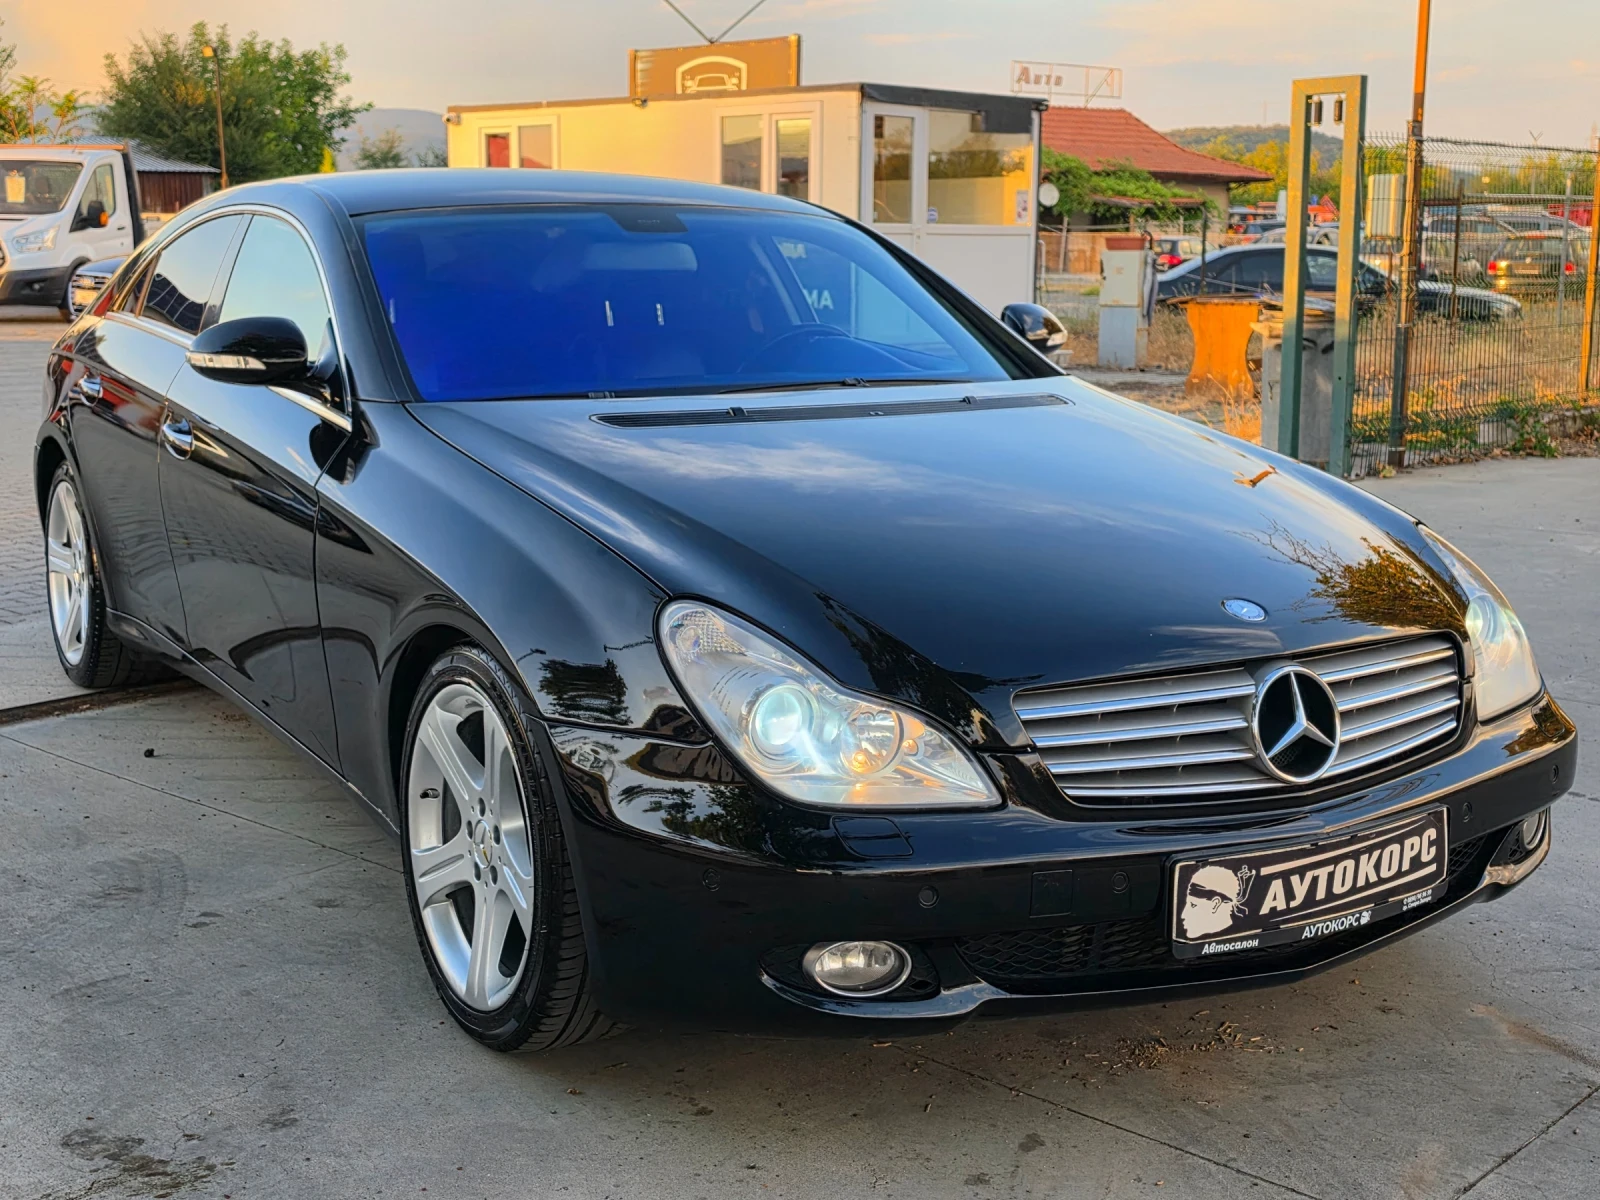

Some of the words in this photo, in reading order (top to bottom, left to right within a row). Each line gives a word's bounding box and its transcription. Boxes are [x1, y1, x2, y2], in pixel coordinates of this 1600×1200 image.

[1258, 827, 1437, 915] АУТОКОРС
[1301, 913, 1360, 940] АУТОКОРС
[1201, 938, 1259, 955] Автосалон
